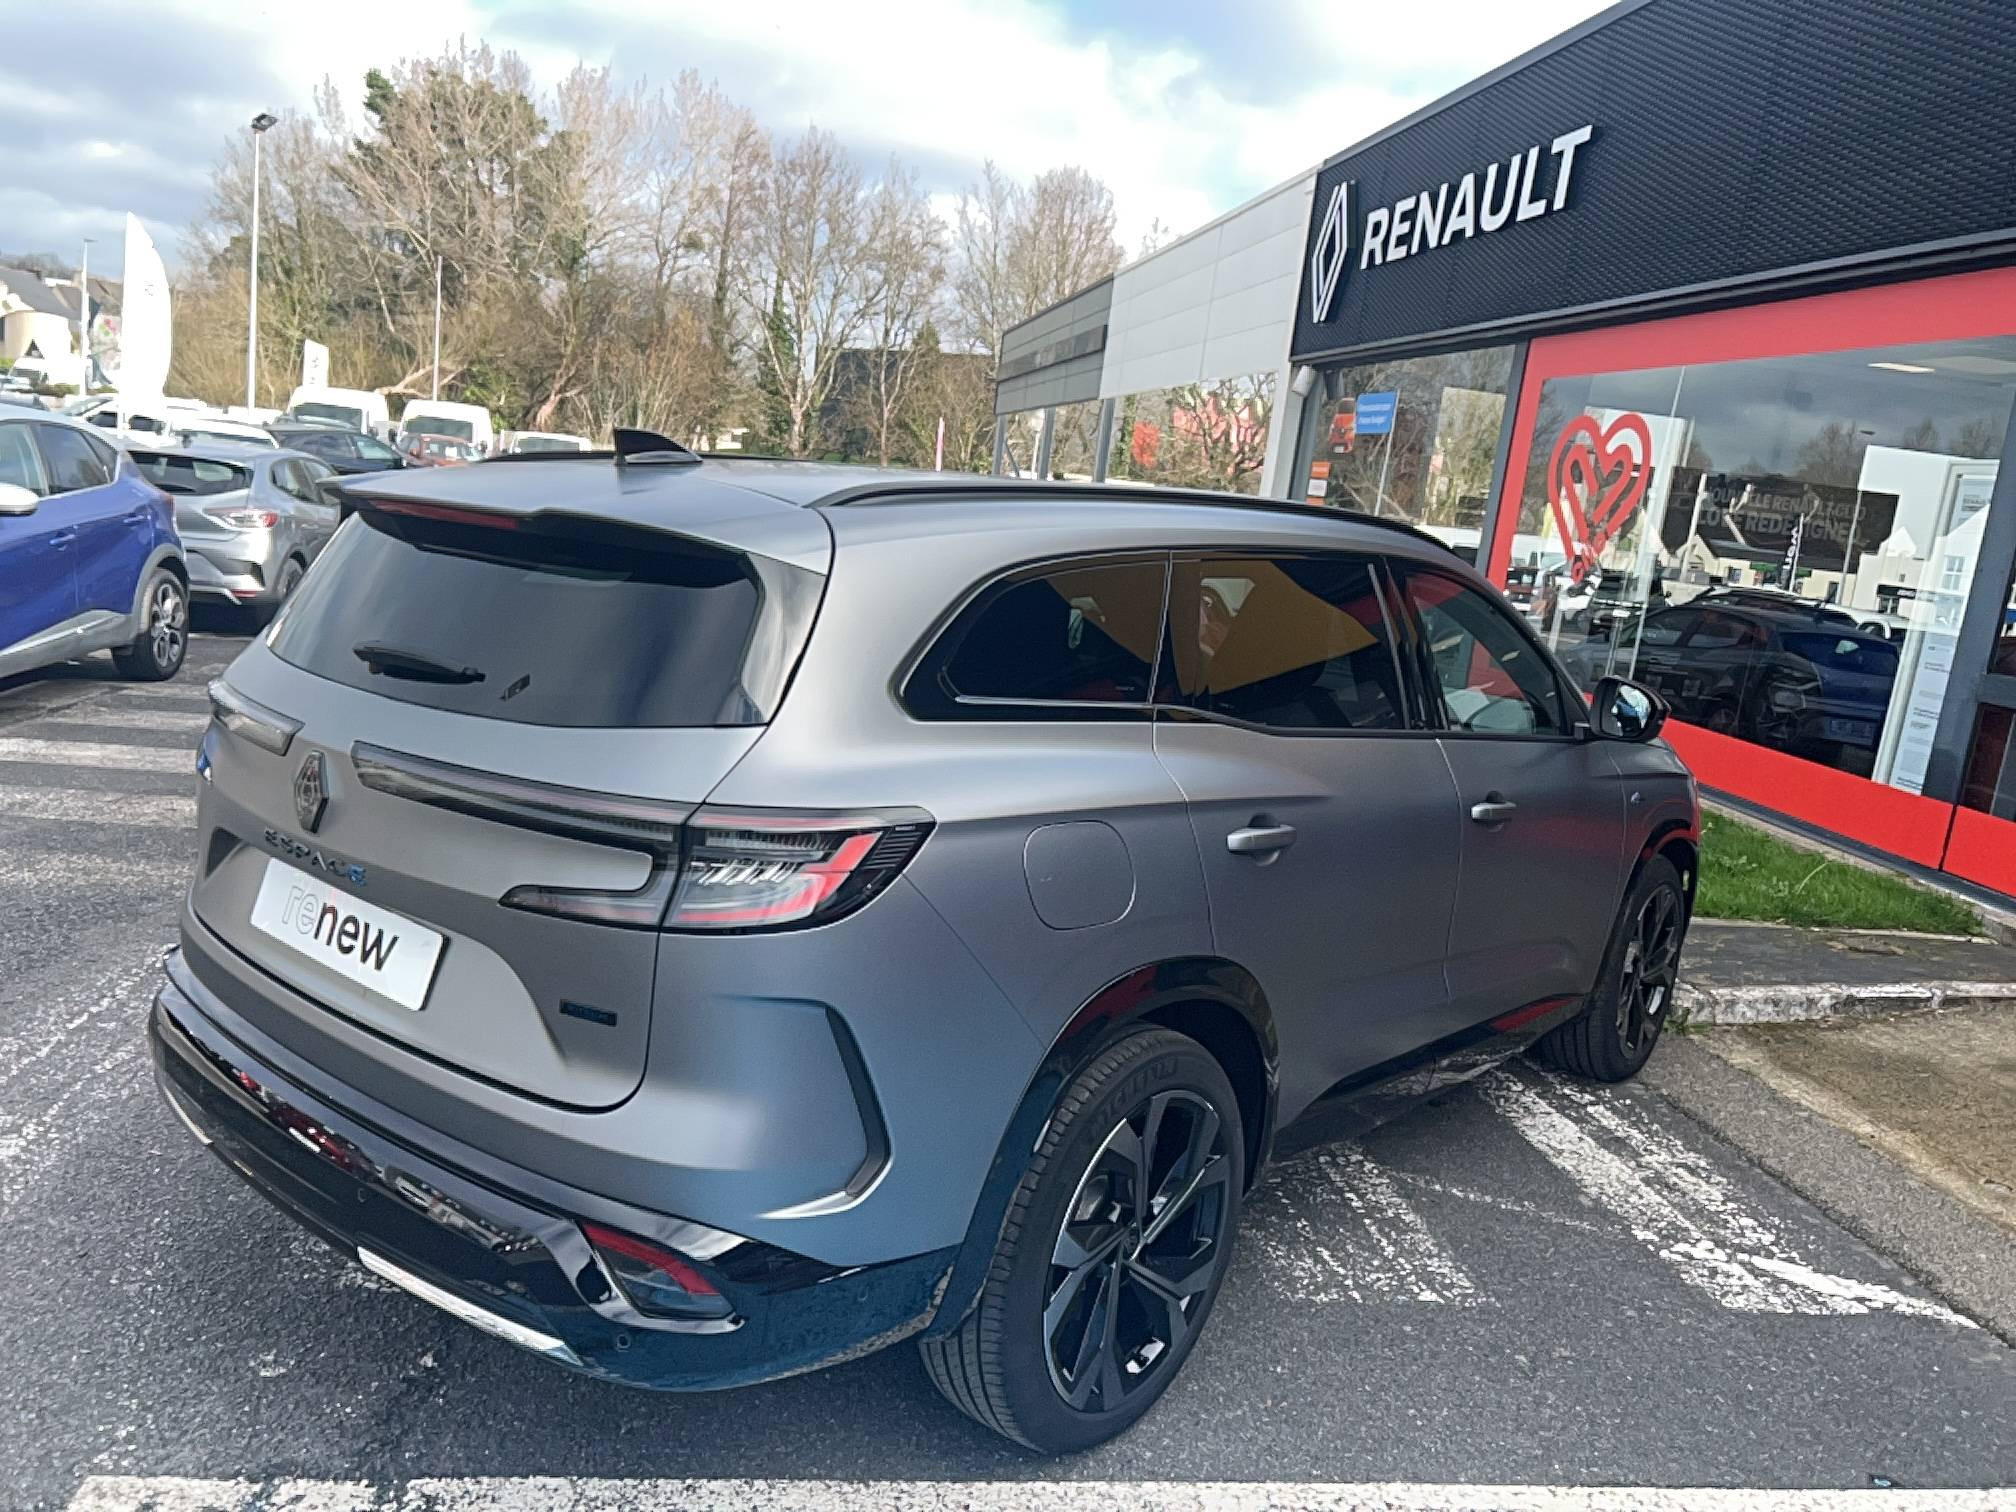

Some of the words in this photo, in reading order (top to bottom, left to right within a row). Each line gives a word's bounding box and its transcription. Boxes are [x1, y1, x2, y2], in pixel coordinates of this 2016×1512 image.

[1360, 124, 1593, 270] RENAULT
[264, 826, 367, 887] ESPACE
[282, 884, 400, 972] renew
